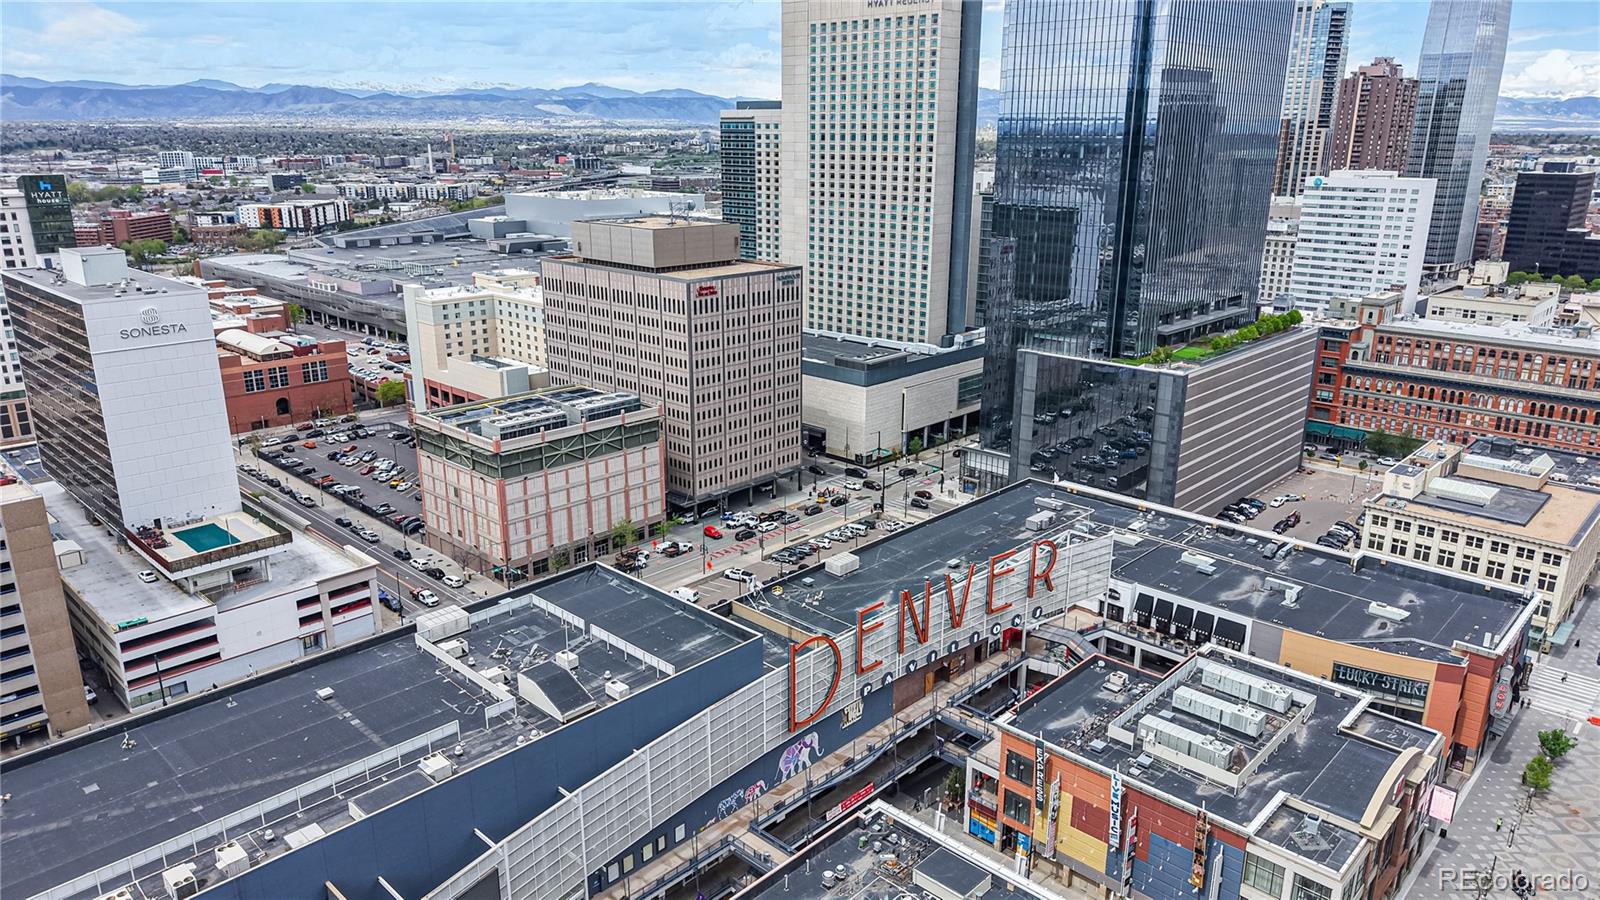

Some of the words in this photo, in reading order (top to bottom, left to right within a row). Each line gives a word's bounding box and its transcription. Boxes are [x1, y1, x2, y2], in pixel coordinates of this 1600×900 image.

[120, 323, 187, 339] SONESTA
[789, 539, 1057, 733] DENVER
[861, 604, 1043, 698] PAVILIONS
[1337, 665, 1379, 686] LUCKY
[1381, 675, 1429, 697] STRIKE
[1036, 748, 1044, 802] EXPRESS
[1112, 774, 1120, 800] LIVE
